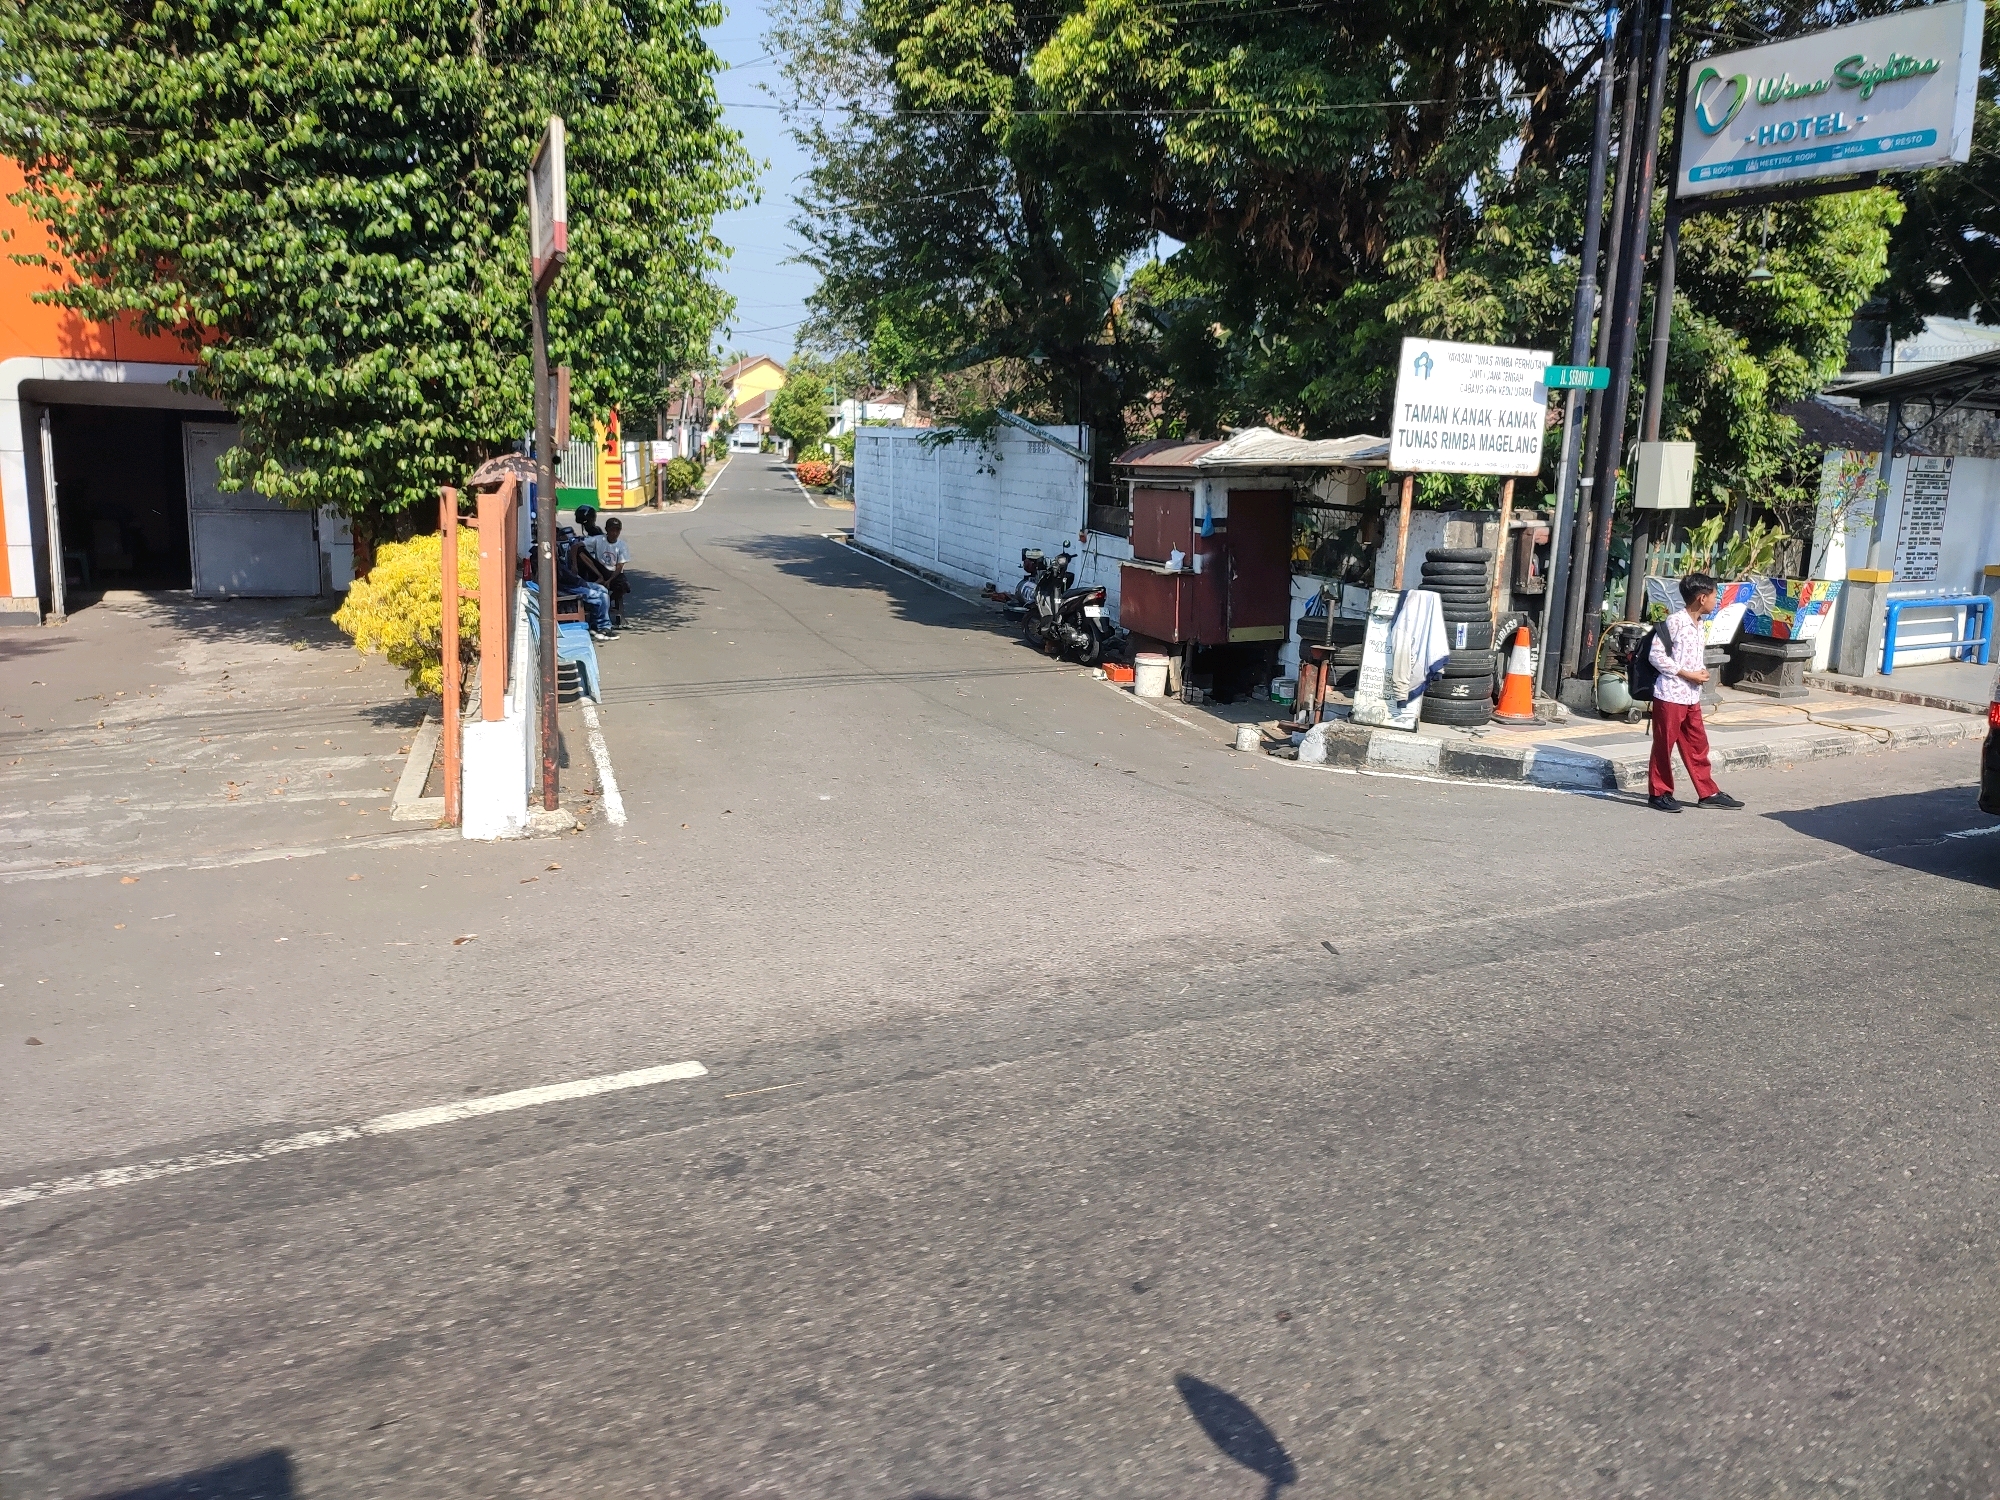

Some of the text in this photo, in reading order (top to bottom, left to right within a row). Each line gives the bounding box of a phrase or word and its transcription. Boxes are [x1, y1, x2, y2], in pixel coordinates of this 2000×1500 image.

[1758, 111, 1853, 147] HOTEL
[1894, 134, 1923, 146] RESTO
[1759, 152, 1817, 168] MEETING ROOM
[1713, 165, 1734, 176] ROOM
[1405, 404, 1448, 424] TAMAN
[1399, 429, 1538, 454] TUNAS RIMBA MAGELANG
